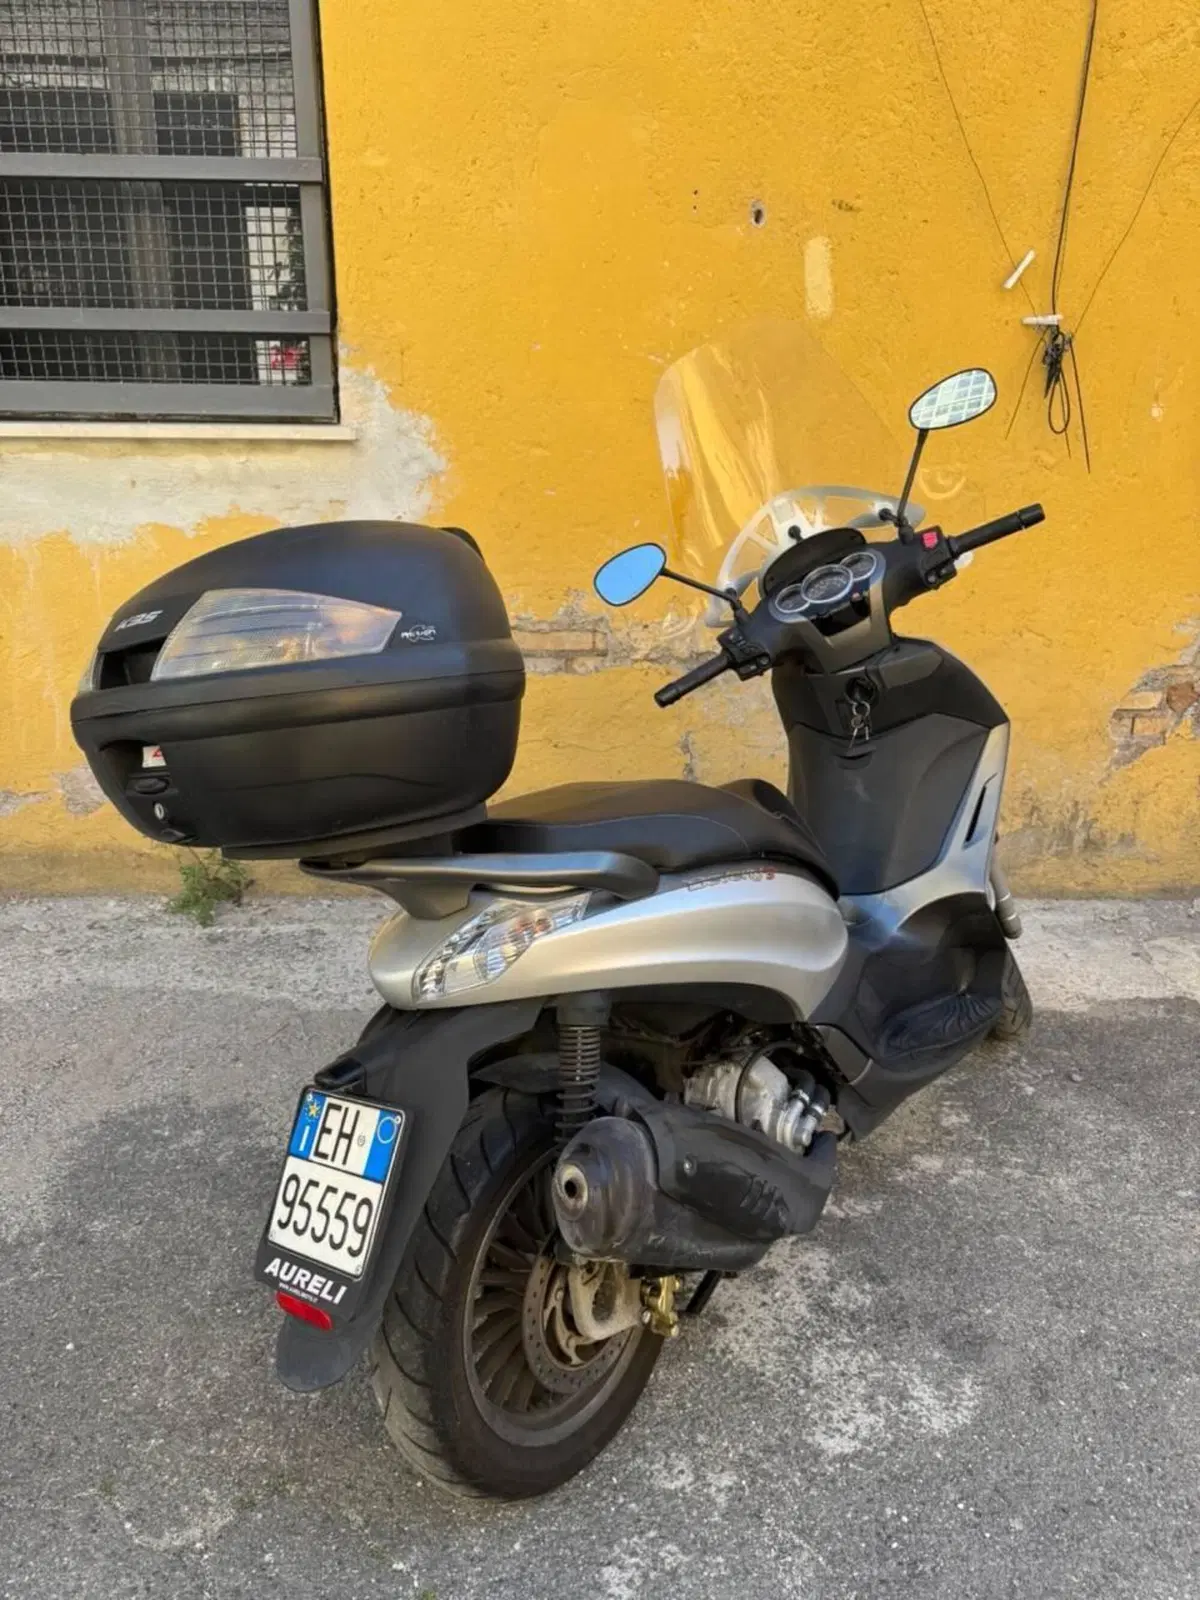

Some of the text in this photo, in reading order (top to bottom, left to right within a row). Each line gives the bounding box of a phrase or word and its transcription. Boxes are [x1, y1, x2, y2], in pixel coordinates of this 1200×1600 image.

[314, 1102, 360, 1166] EH
[277, 1173, 373, 1258] 95559
[264, 1257, 348, 1305] AURELI
